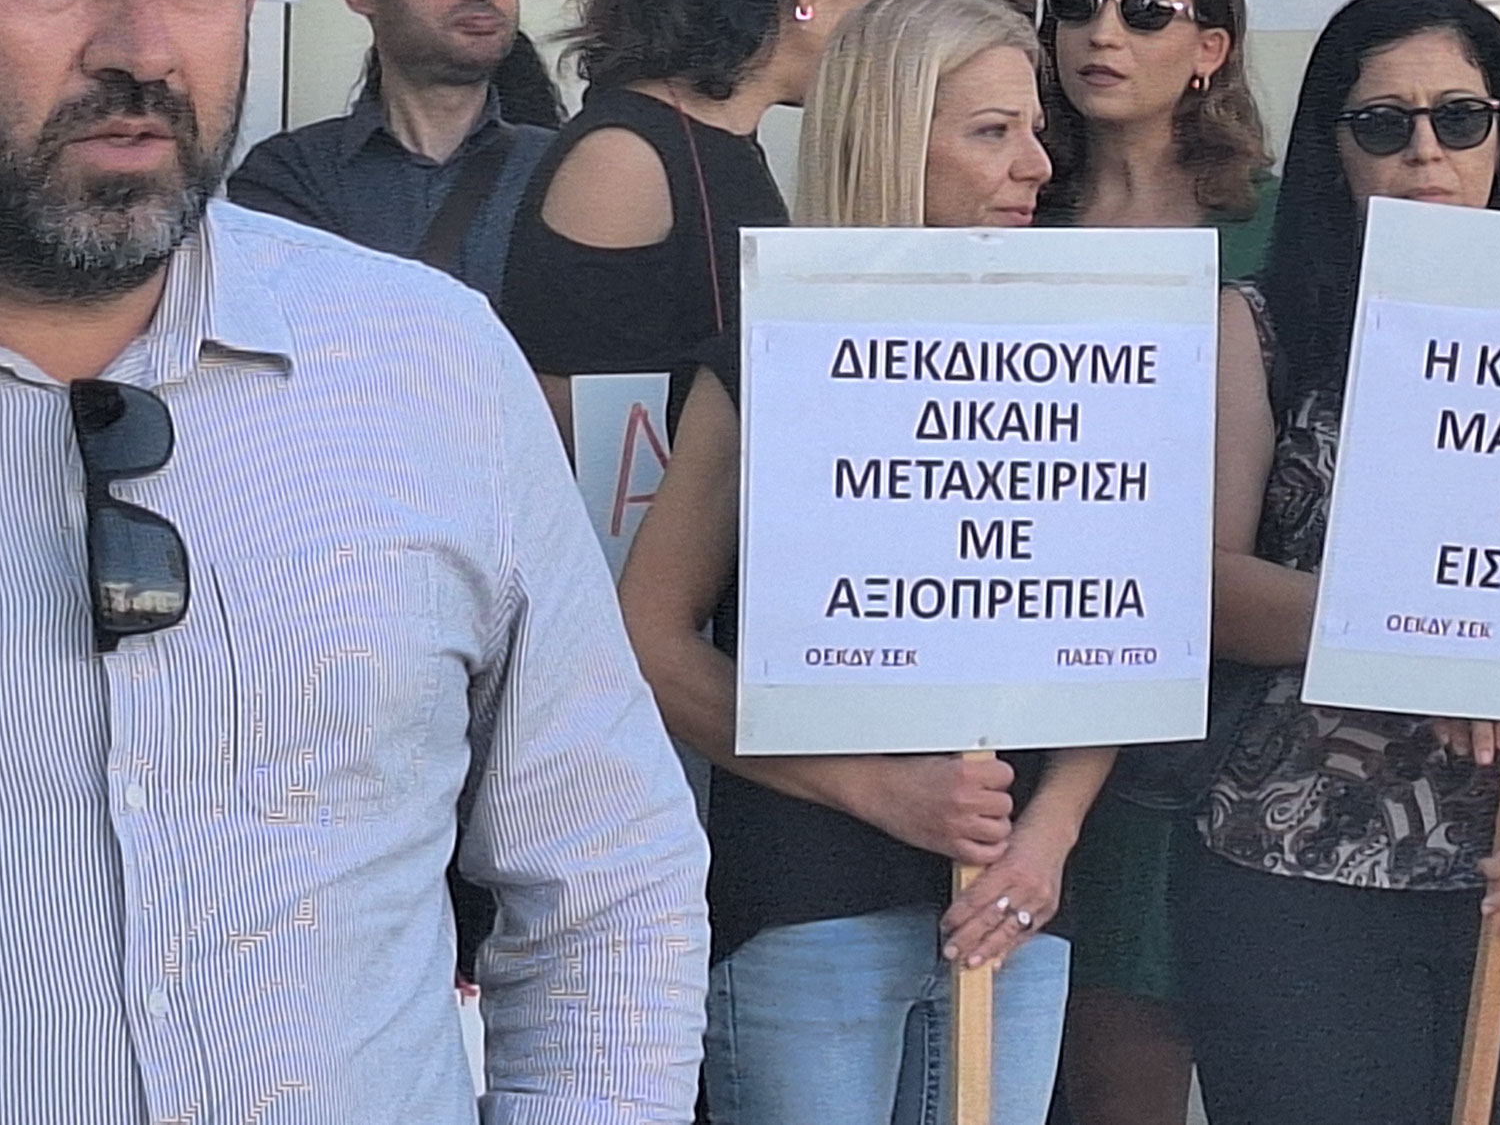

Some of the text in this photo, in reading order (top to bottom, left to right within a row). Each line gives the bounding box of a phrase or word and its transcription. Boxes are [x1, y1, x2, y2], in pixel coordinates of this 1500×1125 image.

[831, 338, 1156, 384] ΔΙΕΚΔΙΚΟΥΜΕ
[1425, 339, 1460, 383] Η
[915, 400, 1079, 442] ΔΙΚΑΙΗ
[835, 458, 1147, 502] ΜΕΤΑΧΕΙΡΙΣΗ
[960, 519, 1033, 560] ΜΕ
[825, 577, 1144, 619] ΑΞΙΟΠΡΕΠΕΙΑ
[1386, 614, 1490, 638] ΟΕΚΔΥ ΣΕΚ
[805, 648, 916, 667] ΟΕΚΔΥ ΣΕΚ
[1057, 647, 1157, 666] ΠΑΣΕΥ ΠΕΟ
